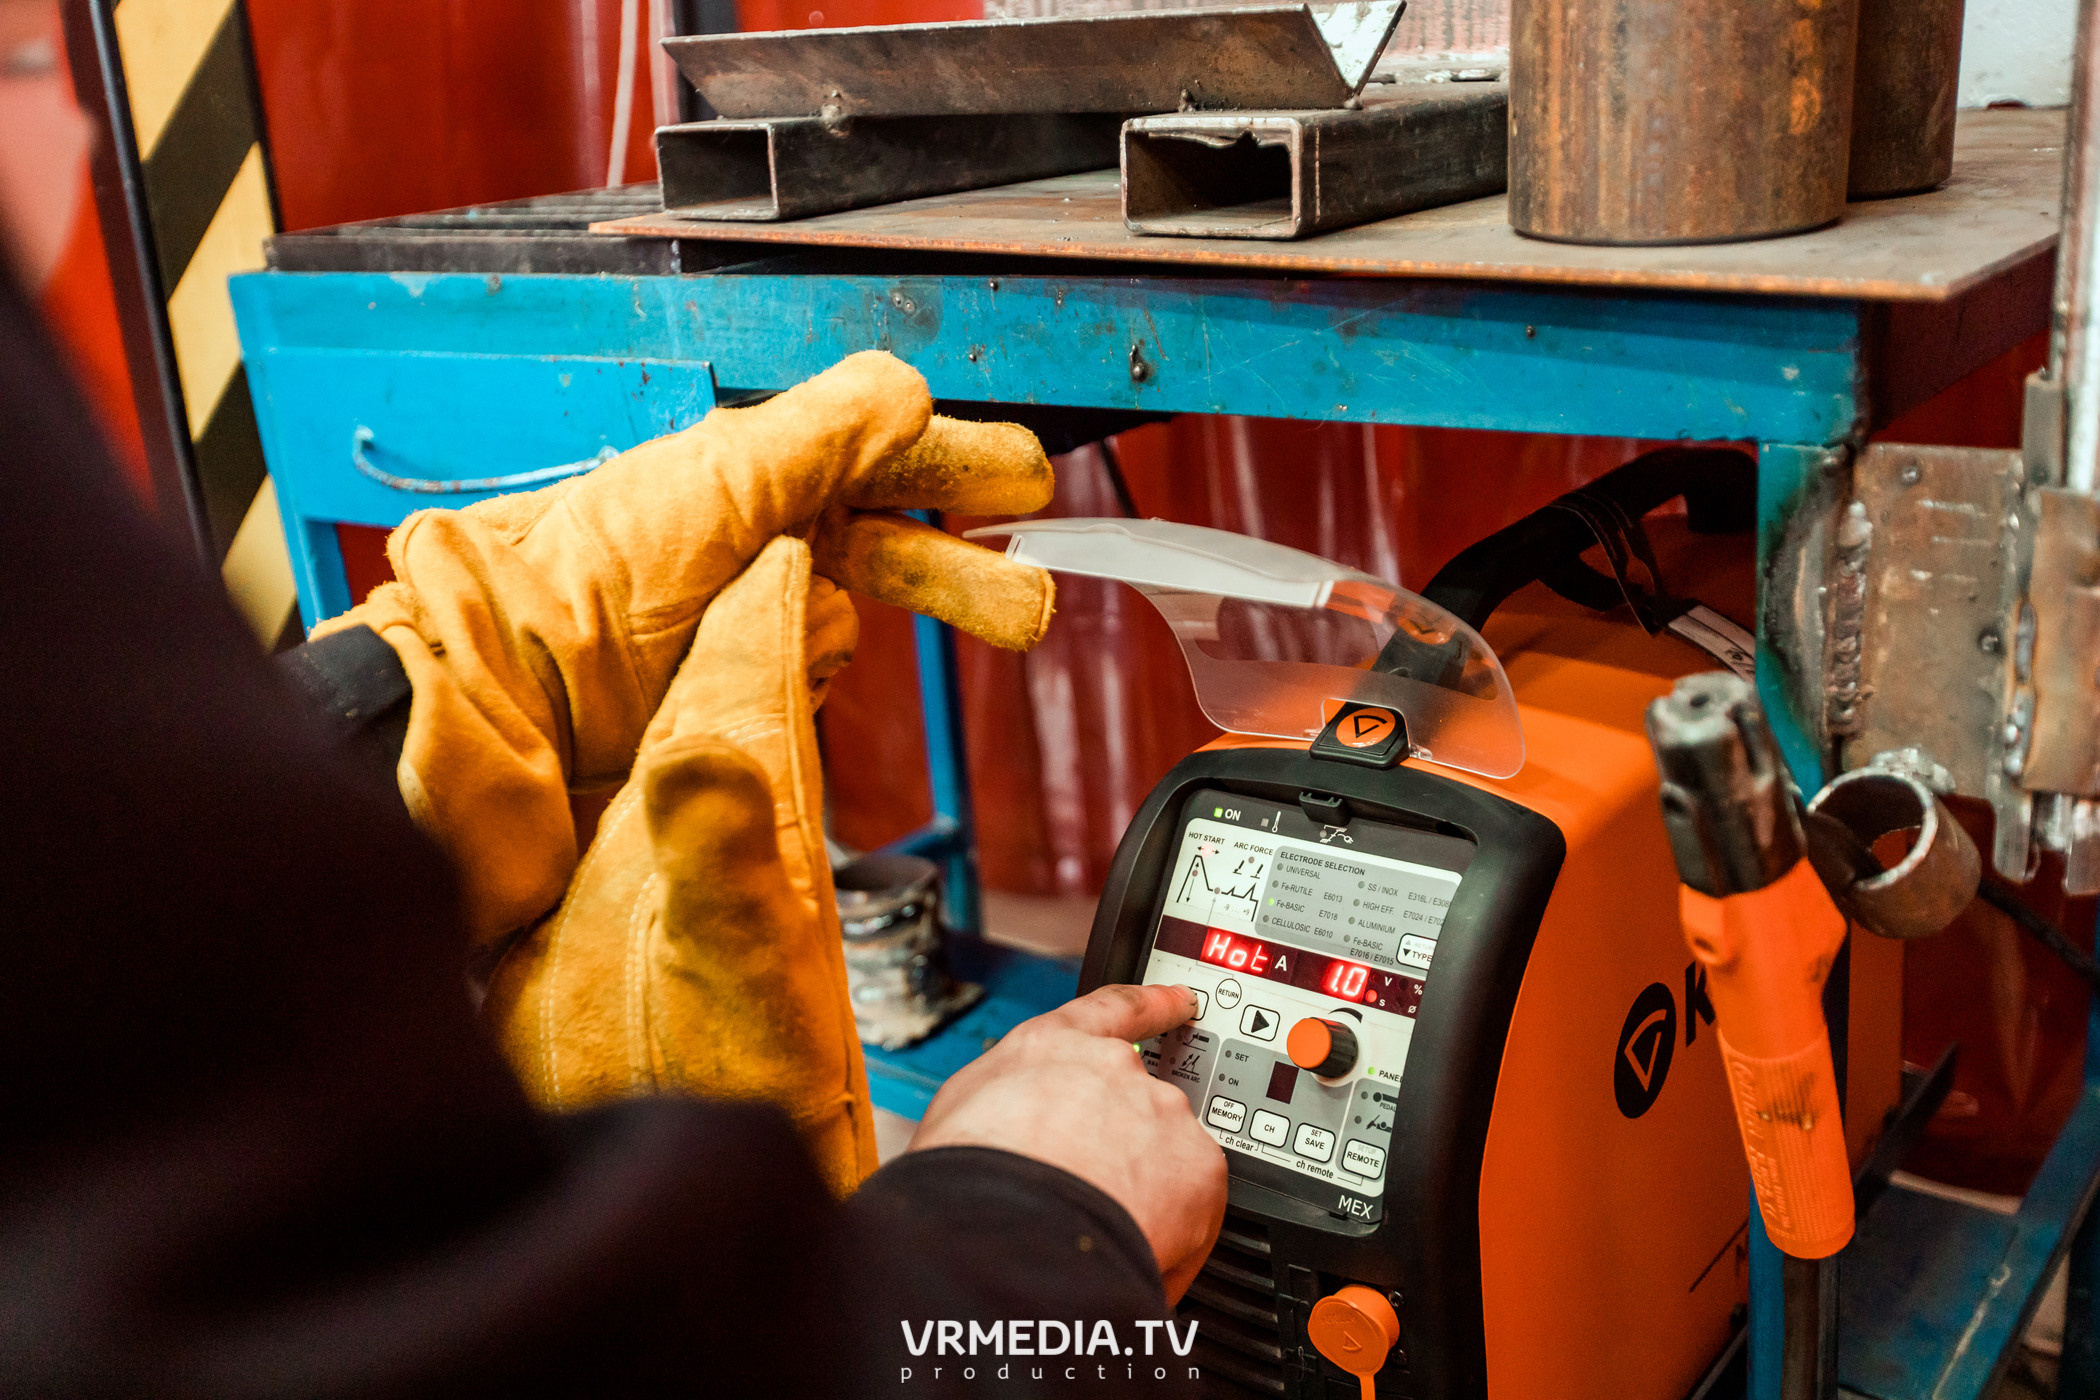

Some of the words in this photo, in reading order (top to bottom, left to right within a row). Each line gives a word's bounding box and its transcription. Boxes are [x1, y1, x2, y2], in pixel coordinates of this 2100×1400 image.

[1225, 808, 1241, 821] ON
[1188, 832, 1202, 840] HOT
[1203, 835, 1225, 845] START
[1234, 842, 1249, 850] ARC
[1250, 845, 1274, 856] FORCE
[1280, 852, 1323, 867] ELECTRODE
[1324, 861, 1366, 876] SELECTION
[1286, 865, 1321, 880] UNIVERSAL
[1281, 882, 1313, 896] Fe-RUTILE
[1323, 891, 1343, 903] E6013
[1367, 883, 1377, 892] SS
[1381, 885, 1399, 897] INOX
[1408, 891, 1428, 904] E316L
[1276, 900, 1305, 913] Fe-BASIC
[1318, 909, 1338, 921] E7018
[1362, 902, 1379, 913] HIGH
[1403, 910, 1423, 922] E7024
[1271, 917, 1311, 933] CELLULOSIC
[1314, 927, 1334, 939] E6010
[1357, 919, 1396, 934] ALUMINIUM
[1353, 937, 1384, 951] Fe-BASIC
[1274, 954, 1288, 972] A
[1350, 948, 1369, 960] E7016
[1374, 953, 1395, 966] E7015
[1413, 950, 1432, 963] TYPE
[1330, 964, 1368, 997] 1.0
[1384, 976, 1393, 987] V
[1217, 987, 1240, 999] RETURN
[1234, 1052, 1250, 1063] SET
[1171, 1069, 1190, 1081] BROKEN
[1190, 1075, 1201, 1084] ARC
[1228, 1077, 1240, 1087] ON
[1223, 1100, 1235, 1109] OFF
[1211, 1106, 1243, 1122] MEMORY
[1264, 1124, 1276, 1133] CH
[1310, 1129, 1323, 1138] SET
[1225, 1135, 1235, 1146] ch
[1235, 1138, 1254, 1152] clear
[1304, 1137, 1325, 1150] SAVE
[1346, 1151, 1380, 1168] REMOTE
[1296, 1159, 1306, 1170] ch
[1306, 1163, 1334, 1179] remote
[1338, 1194, 1374, 1220] MEX
